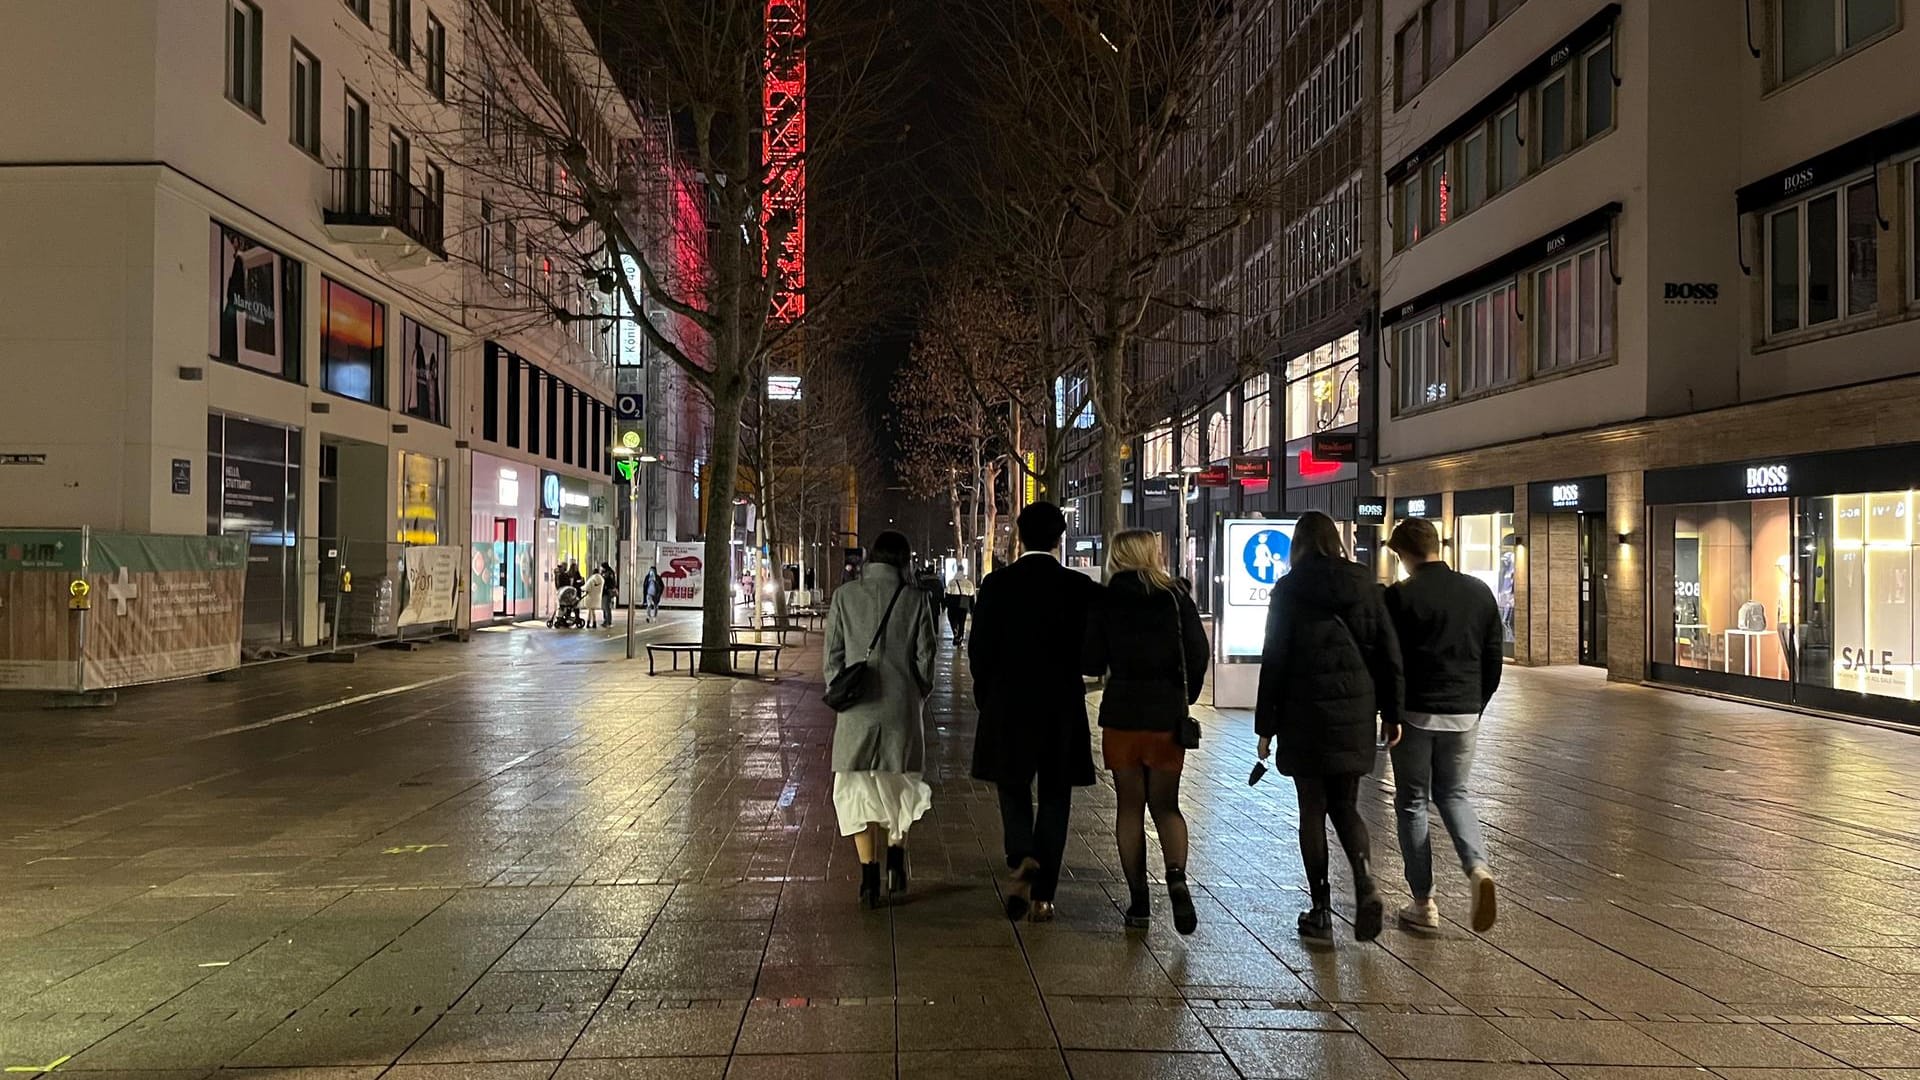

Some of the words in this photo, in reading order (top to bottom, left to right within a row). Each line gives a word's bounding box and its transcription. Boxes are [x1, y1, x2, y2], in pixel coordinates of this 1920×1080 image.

[1784, 168, 1814, 190] BOSS
[1664, 282, 1719, 299] BOSS
[619, 396, 640, 418] O2
[1746, 465, 1788, 488] BOSS
[1552, 484, 1578, 501] BOSS
[1359, 504, 1382, 513] BOSS
[1407, 499, 1425, 512] BOSS
[1249, 587, 1271, 601] ZO
[1842, 646, 1893, 676] SALE
